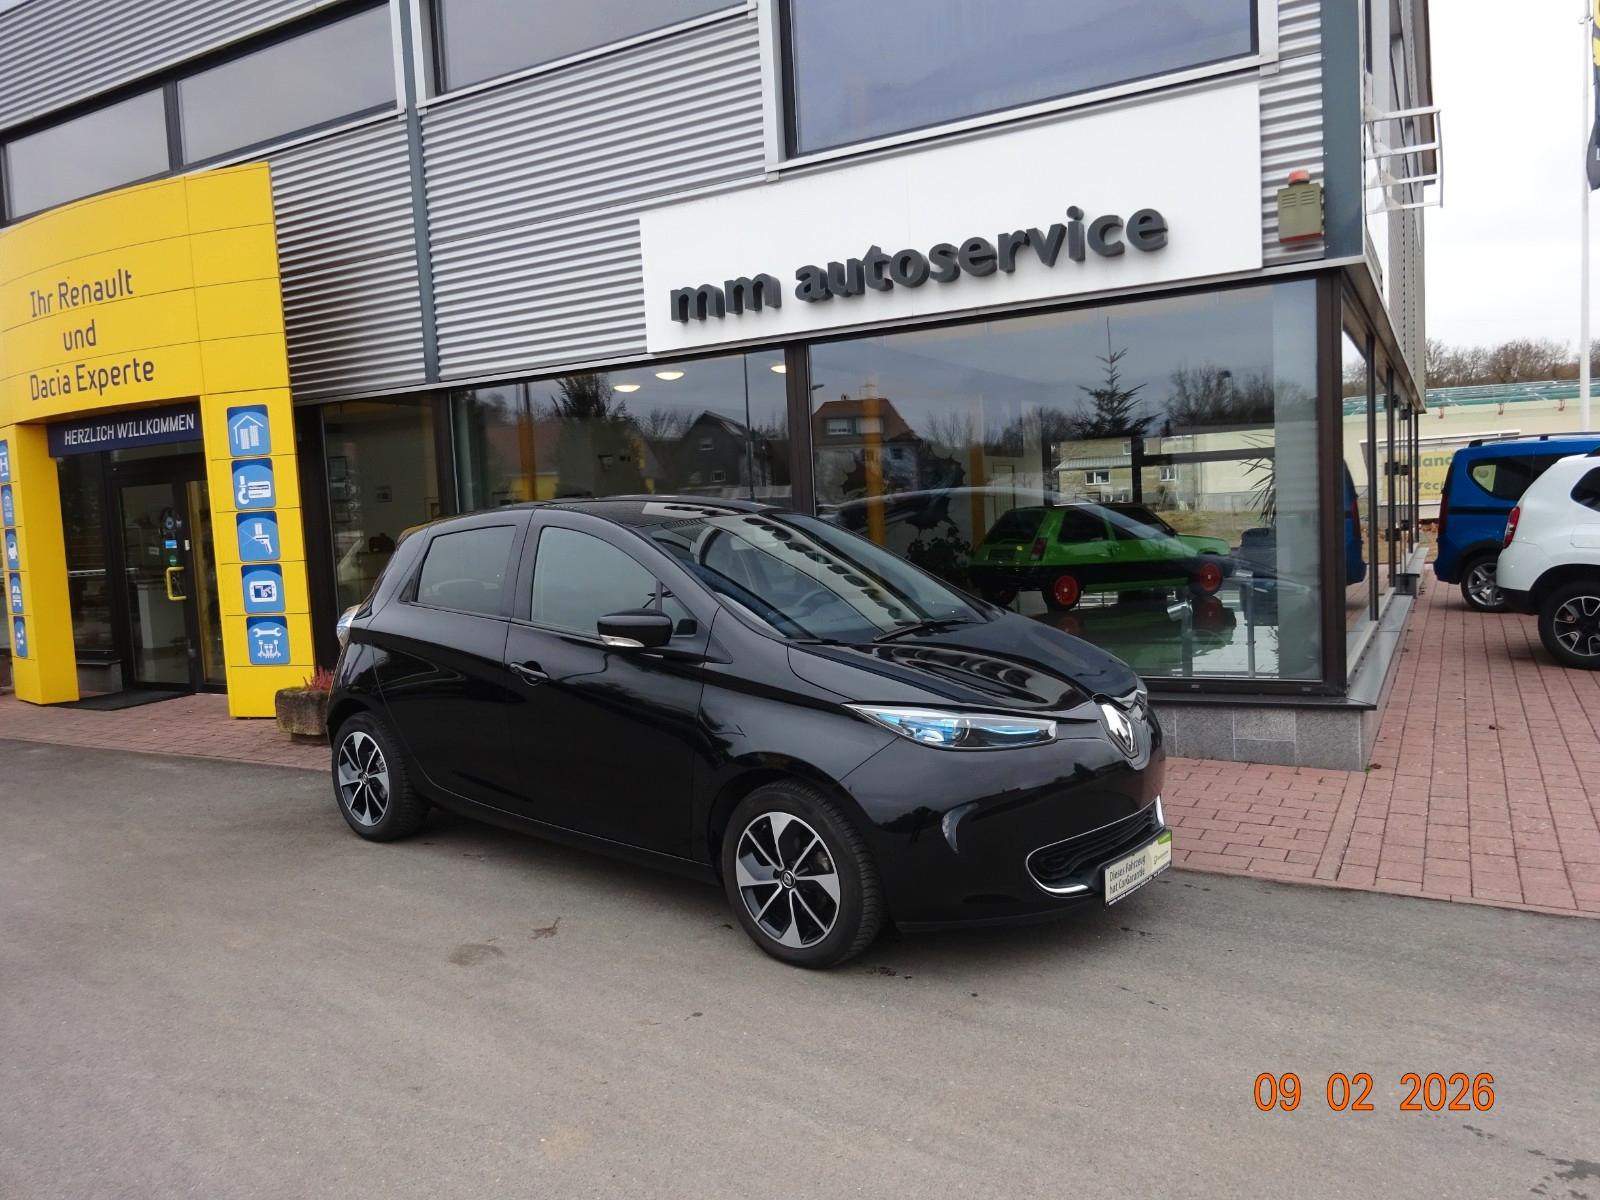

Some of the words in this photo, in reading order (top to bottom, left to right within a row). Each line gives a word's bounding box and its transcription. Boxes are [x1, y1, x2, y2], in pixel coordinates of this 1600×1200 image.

[670, 272, 781, 323] mm
[795, 205, 1168, 303] autoservice
[30, 290, 52, 318] Ihr
[58, 268, 133, 310] Renault
[63, 319, 97, 351] und
[30, 368, 71, 401] Dacia
[75, 358, 155, 396] Experte
[64, 425, 115, 446] HERZLICH
[117, 413, 195, 439] WILLKOMMEN
